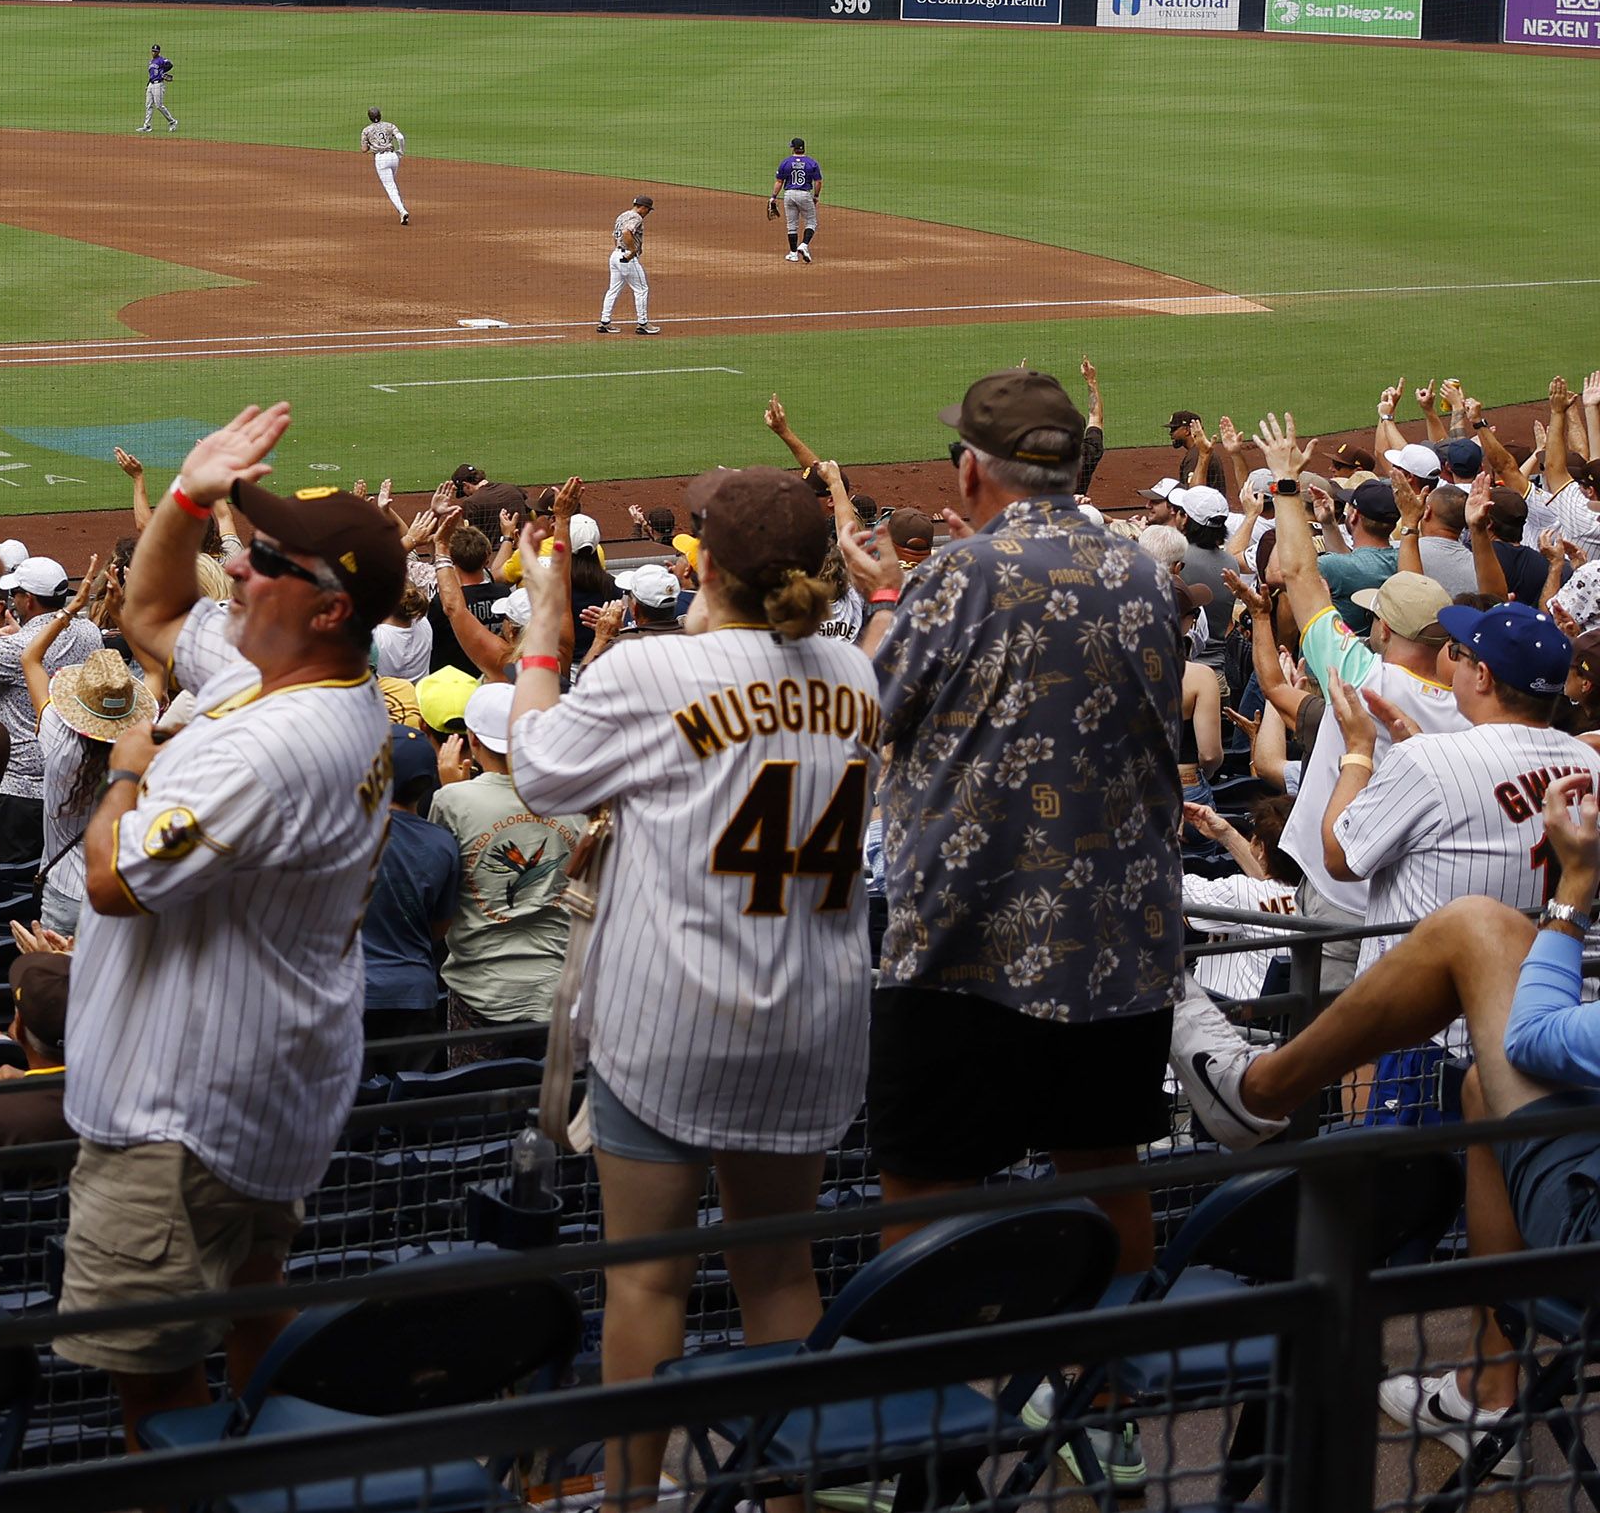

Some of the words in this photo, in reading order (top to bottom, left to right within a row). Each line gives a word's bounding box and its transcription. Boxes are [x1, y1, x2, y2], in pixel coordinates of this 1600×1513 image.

[1158, 9, 1218, 18] UNIVERSITY
[1305, 3, 1335, 19] San
[1337, 6, 1381, 22] Diego
[1383, 6, 1415, 21] Zoo
[1523, 18, 1589, 38] NEXEN
[790, 169, 805, 186] 16
[1049, 568, 1094, 587] PADRES
[710, 759, 869, 918] 44
